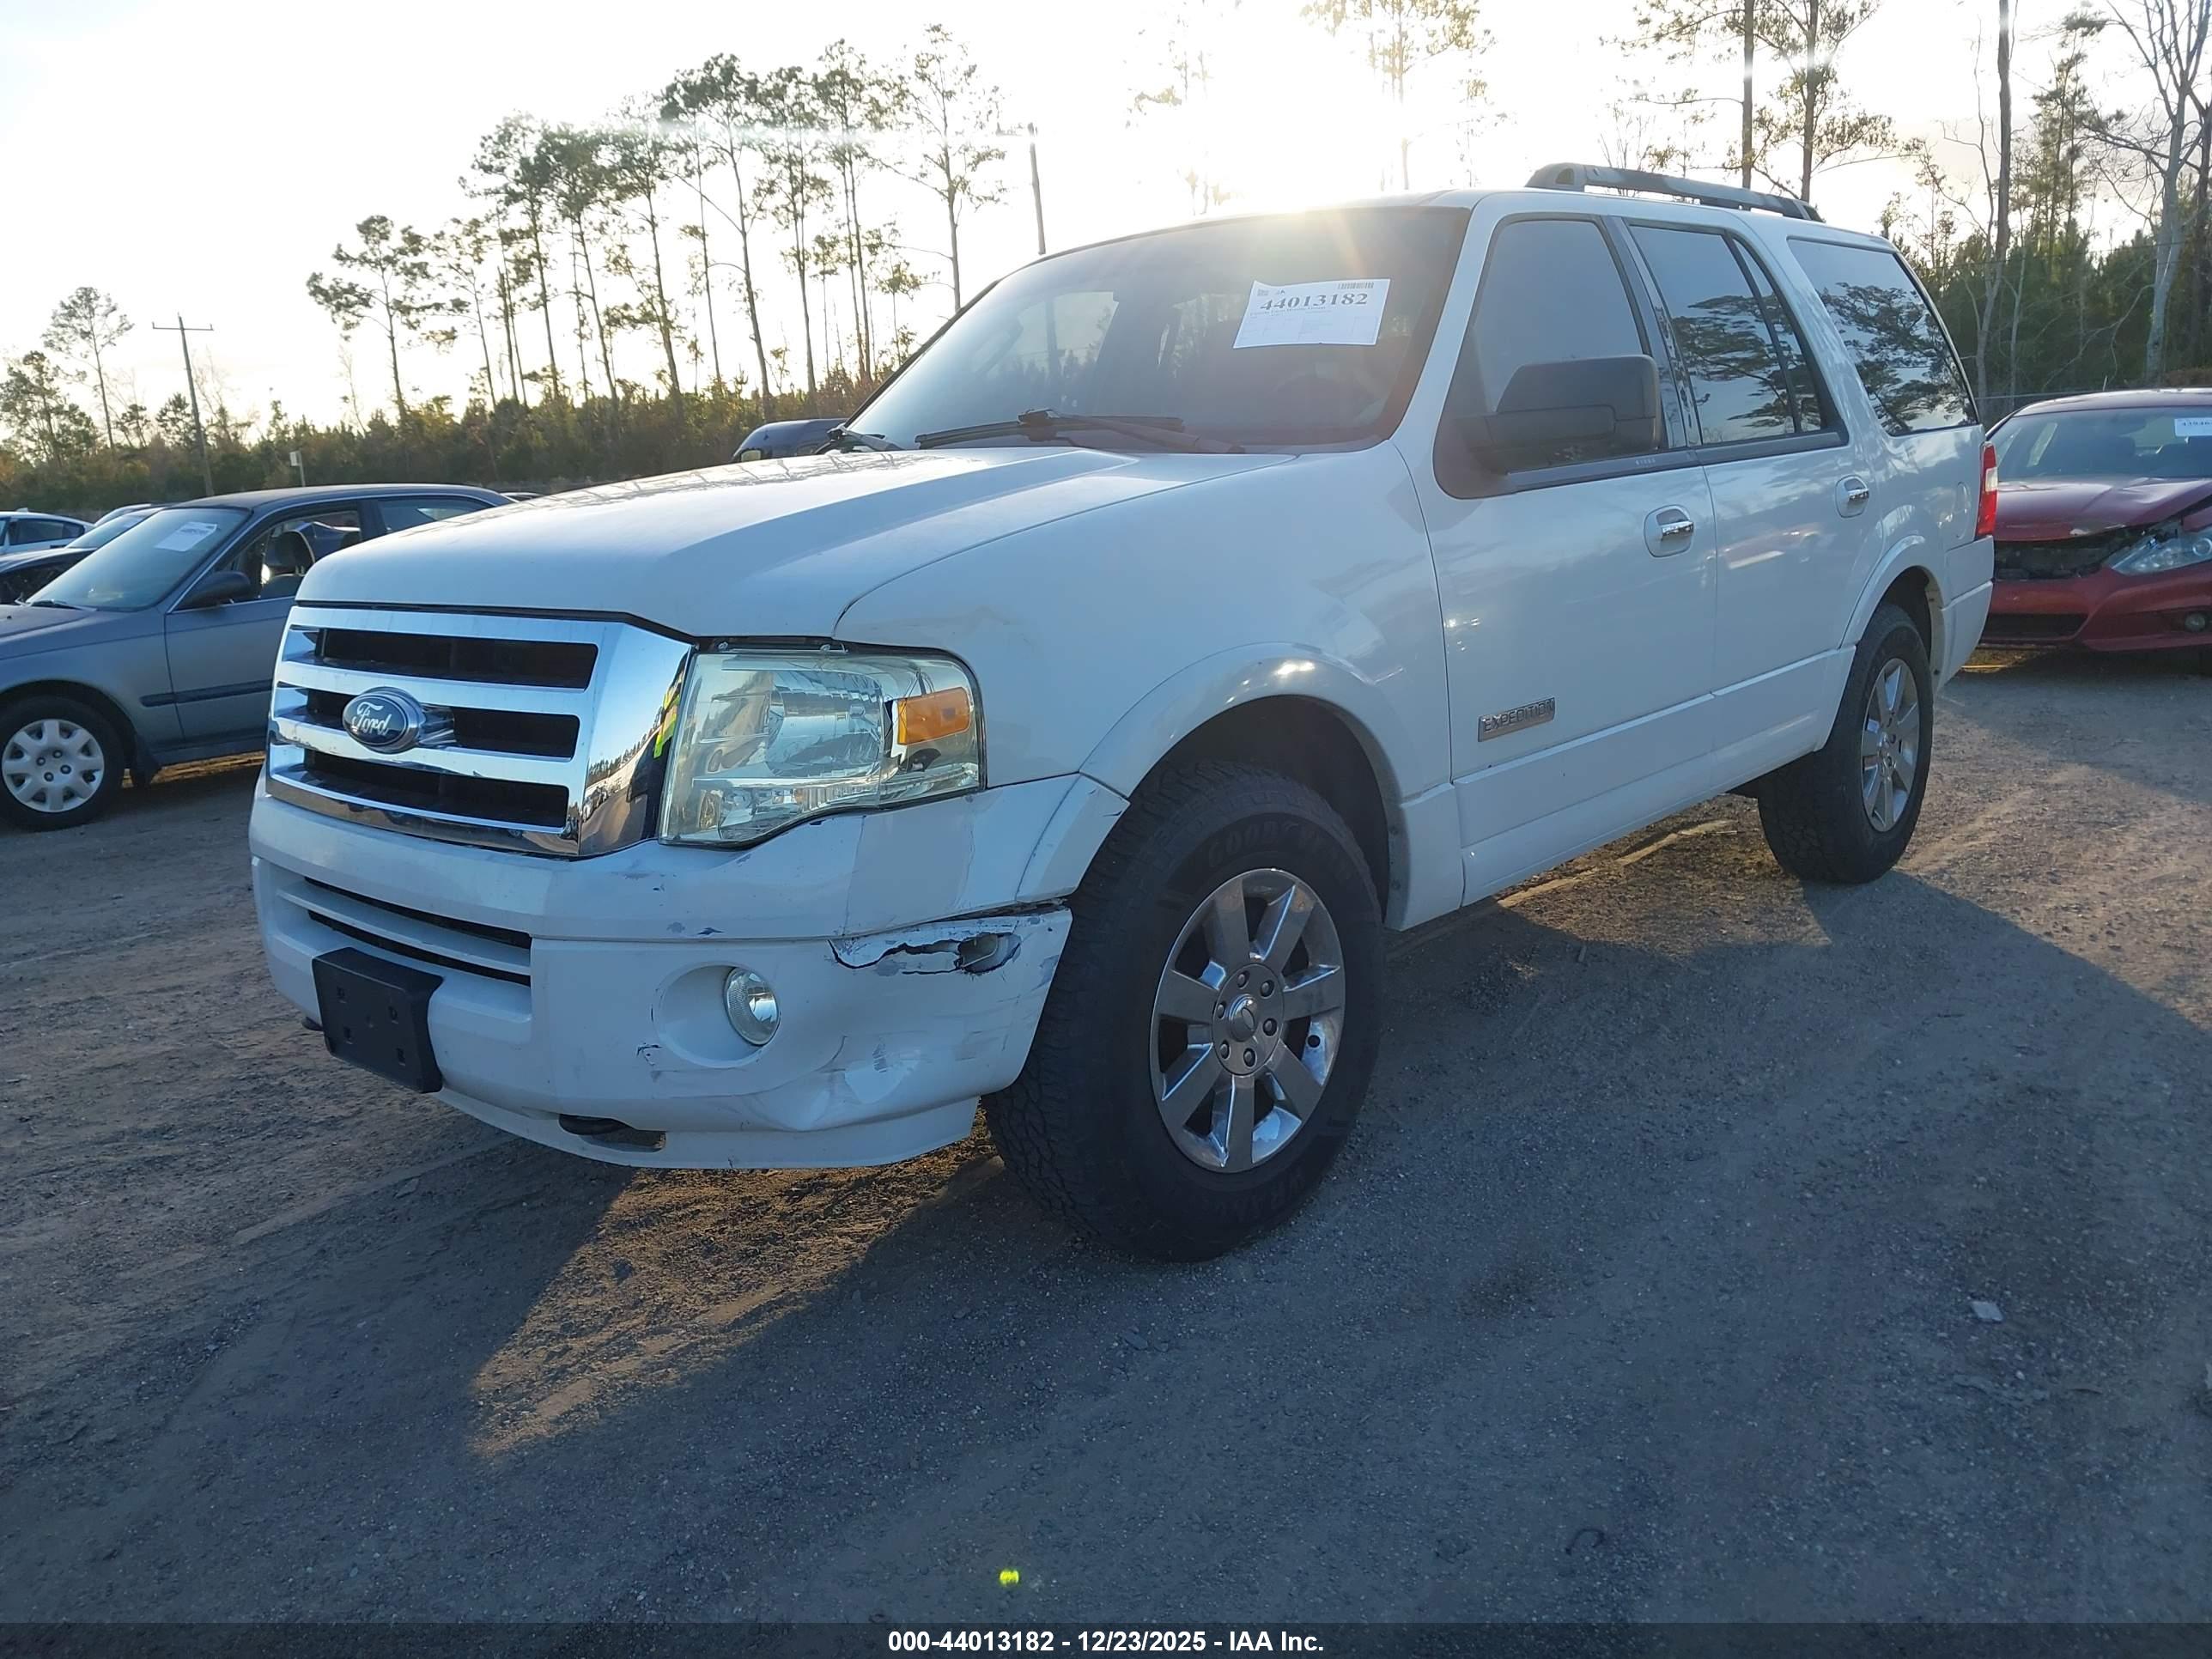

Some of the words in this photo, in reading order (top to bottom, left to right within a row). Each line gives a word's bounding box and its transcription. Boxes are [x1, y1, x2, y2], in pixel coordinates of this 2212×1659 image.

[1260, 293, 1368, 311] 44013182
[351, 701, 392, 737] Ford
[1484, 699, 1554, 732] EXPEDITION
